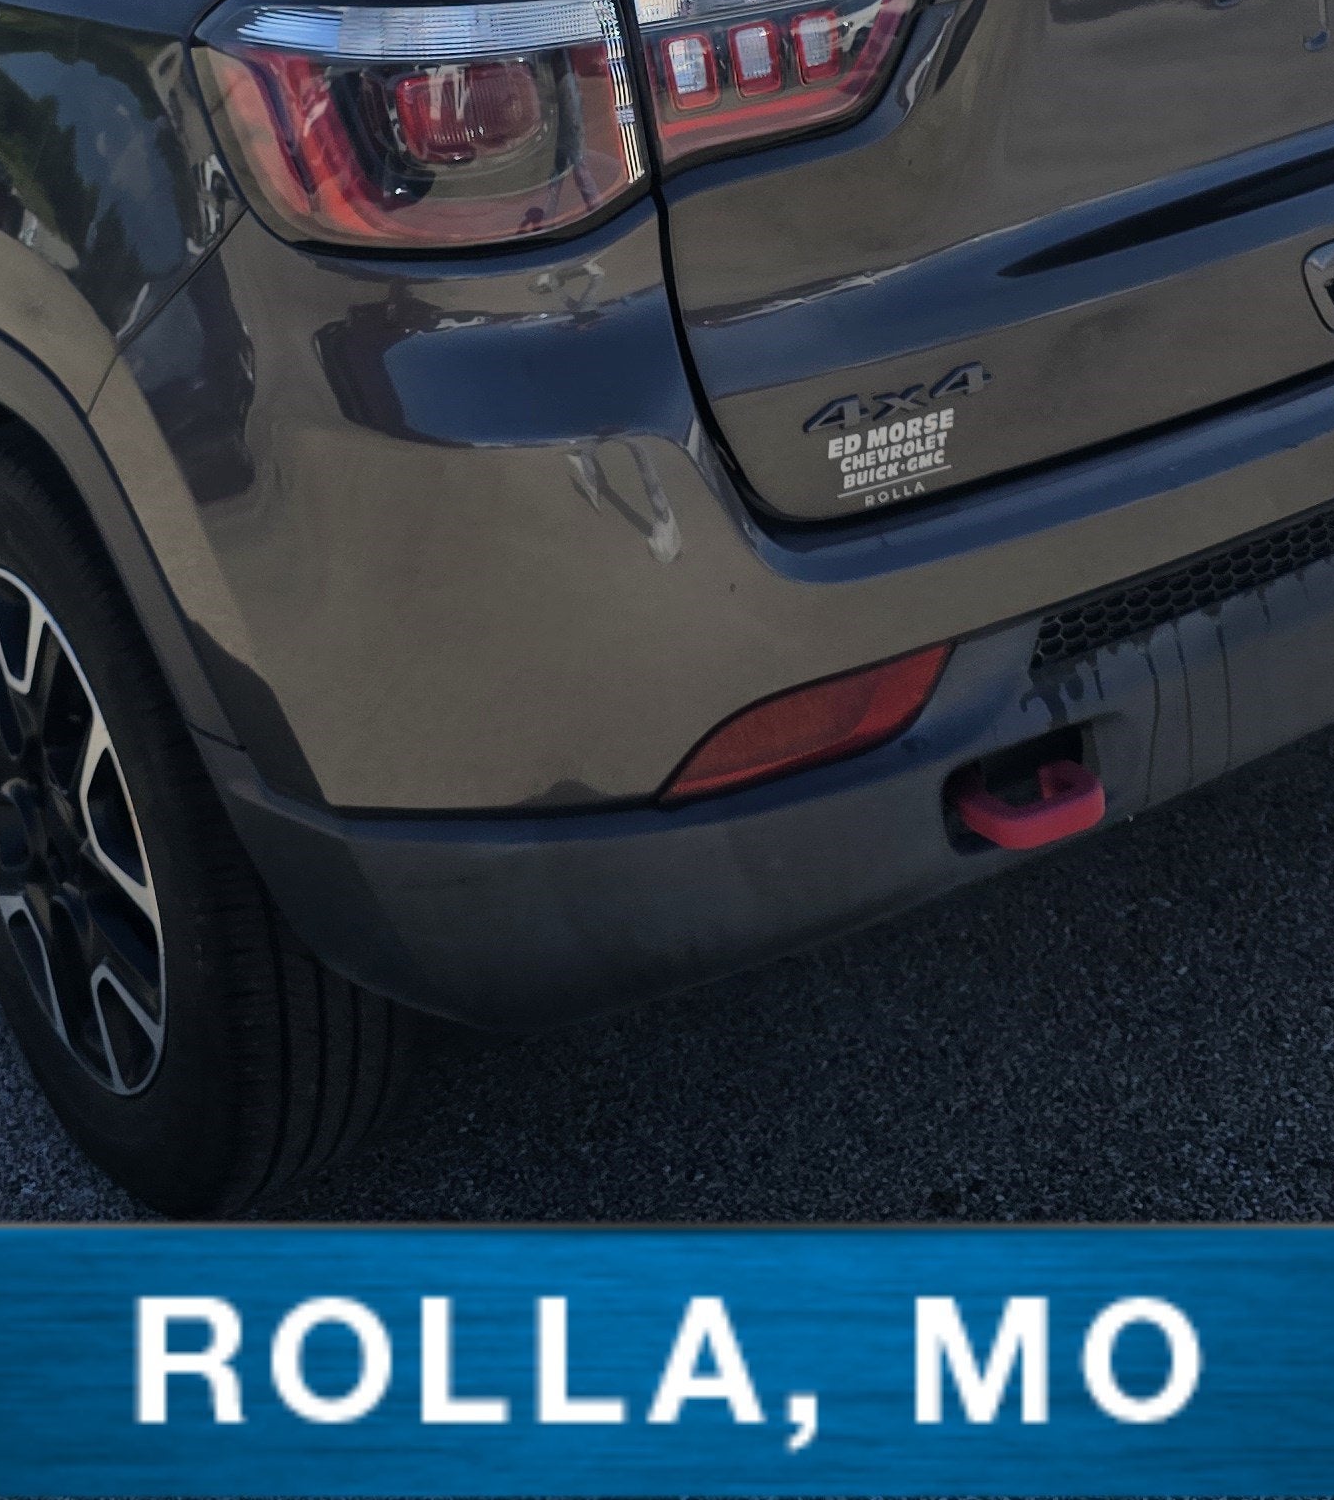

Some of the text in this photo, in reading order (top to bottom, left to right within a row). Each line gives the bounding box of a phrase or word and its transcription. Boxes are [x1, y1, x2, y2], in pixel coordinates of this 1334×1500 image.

[827, 407, 955, 460] ED MORSE
[840, 431, 948, 473] CHEVROLET
[864, 481, 926, 508] ROLLA
